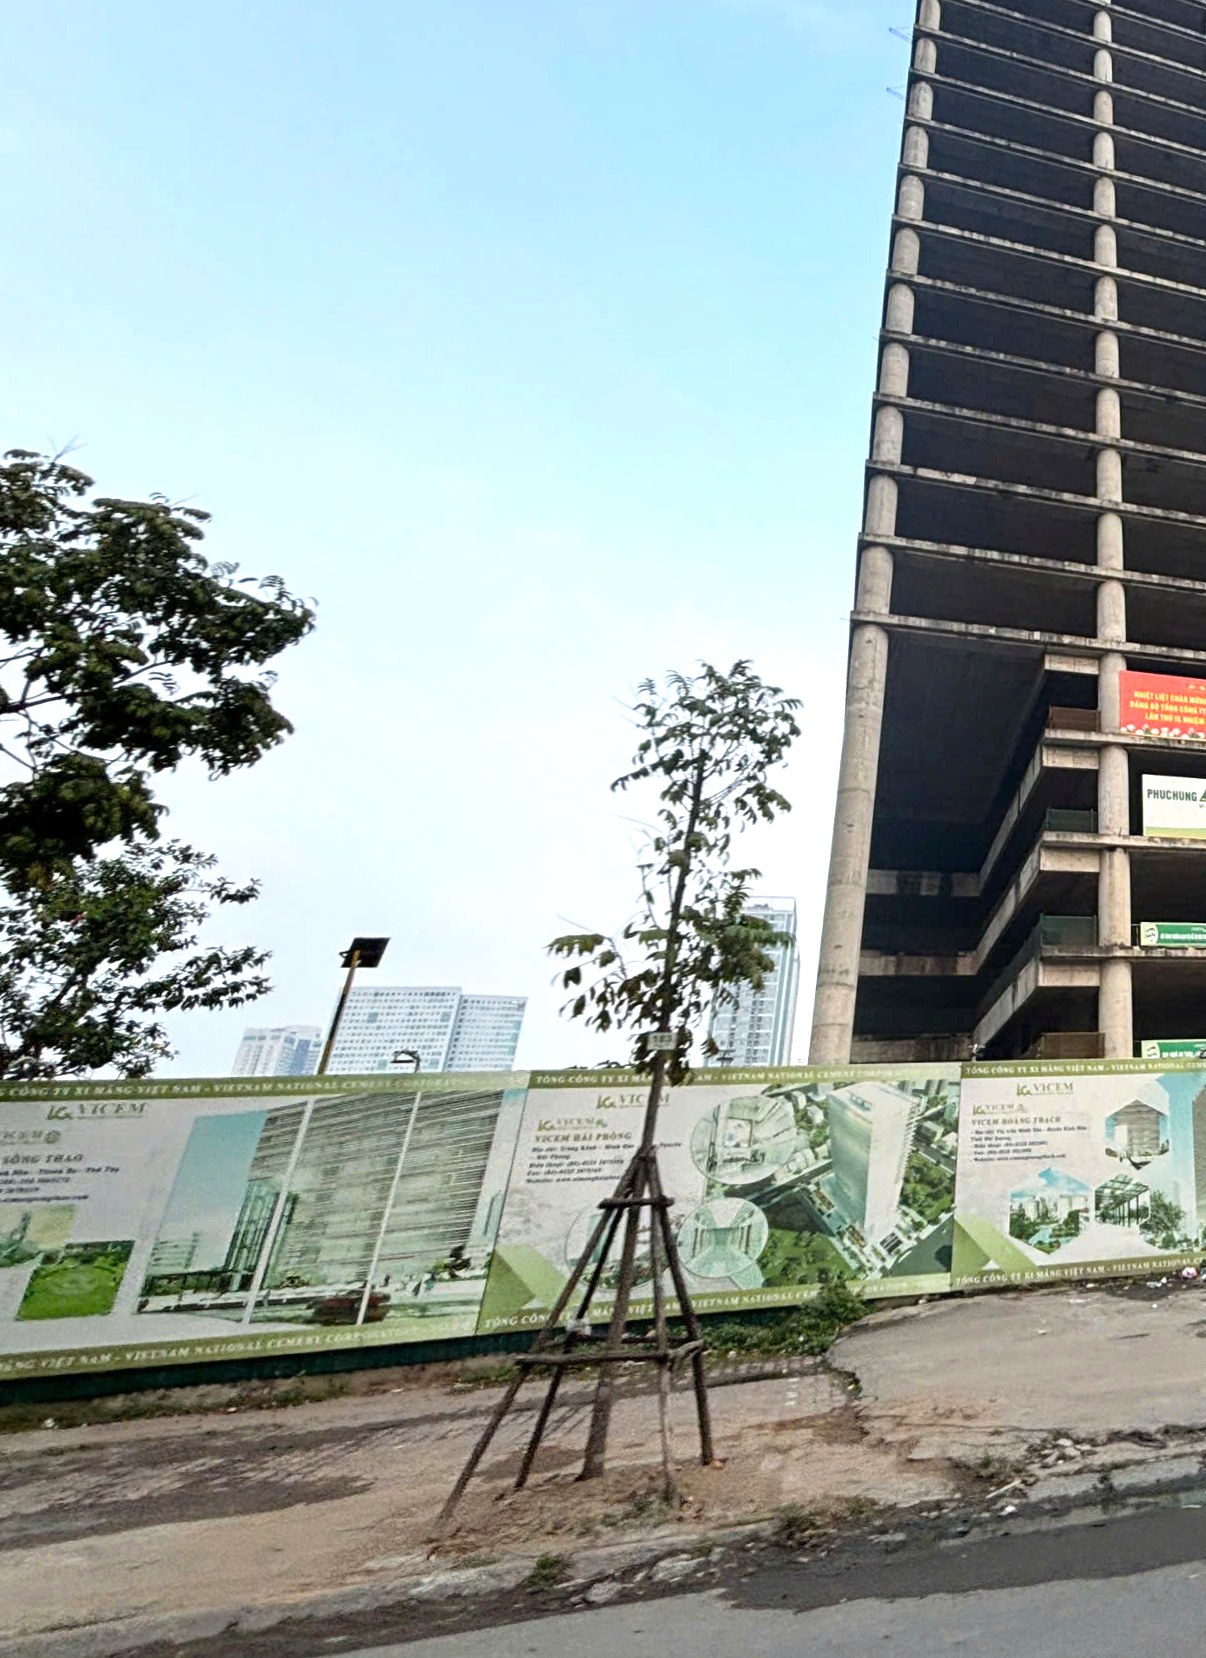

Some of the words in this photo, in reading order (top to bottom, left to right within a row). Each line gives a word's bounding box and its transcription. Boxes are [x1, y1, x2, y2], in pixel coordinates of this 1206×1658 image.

[1134, 691, 1154, 702] NHIỆT
[1147, 788, 1197, 802] PHUCHUNG
[966, 1065, 989, 1075] TỔNG
[991, 1065, 1014, 1074] CÔNG
[1030, 1065, 1039, 1073] XI
[1041, 1064, 1064, 1072] MĂNG
[1066, 1064, 1085, 1073] VIỆT
[1111, 1063, 1146, 1071] VIETNAM
[536, 1073, 565, 1084] TỔNG
[568, 1073, 598, 1084] CÔNG
[601, 1075, 614, 1083] TY
[617, 1075, 630, 1083] XI
[172, 1085, 201, 1095] NAM
[214, 1083, 273, 1093] VIETNAM
[1033, 1082, 1073, 1091] VICEM
[619, 1093, 670, 1105] VICM
[79, 1101, 147, 1115] VICEM
[535, 1133, 570, 1143] VICEM
[596, 1131, 632, 1141] PHÒNG
[956, 1274, 979, 1286] TỔNG
[982, 1273, 1008, 1284] CÔNG
[1024, 1271, 1035, 1280] XI
[1063, 1267, 1084, 1277] VIỆT
[1086, 1266, 1104, 1274] NAM
[1113, 1262, 1150, 1272] VIETNAM
[485, 1315, 517, 1329] TỔNG
[125, 1347, 191, 1362] VIETNAM
